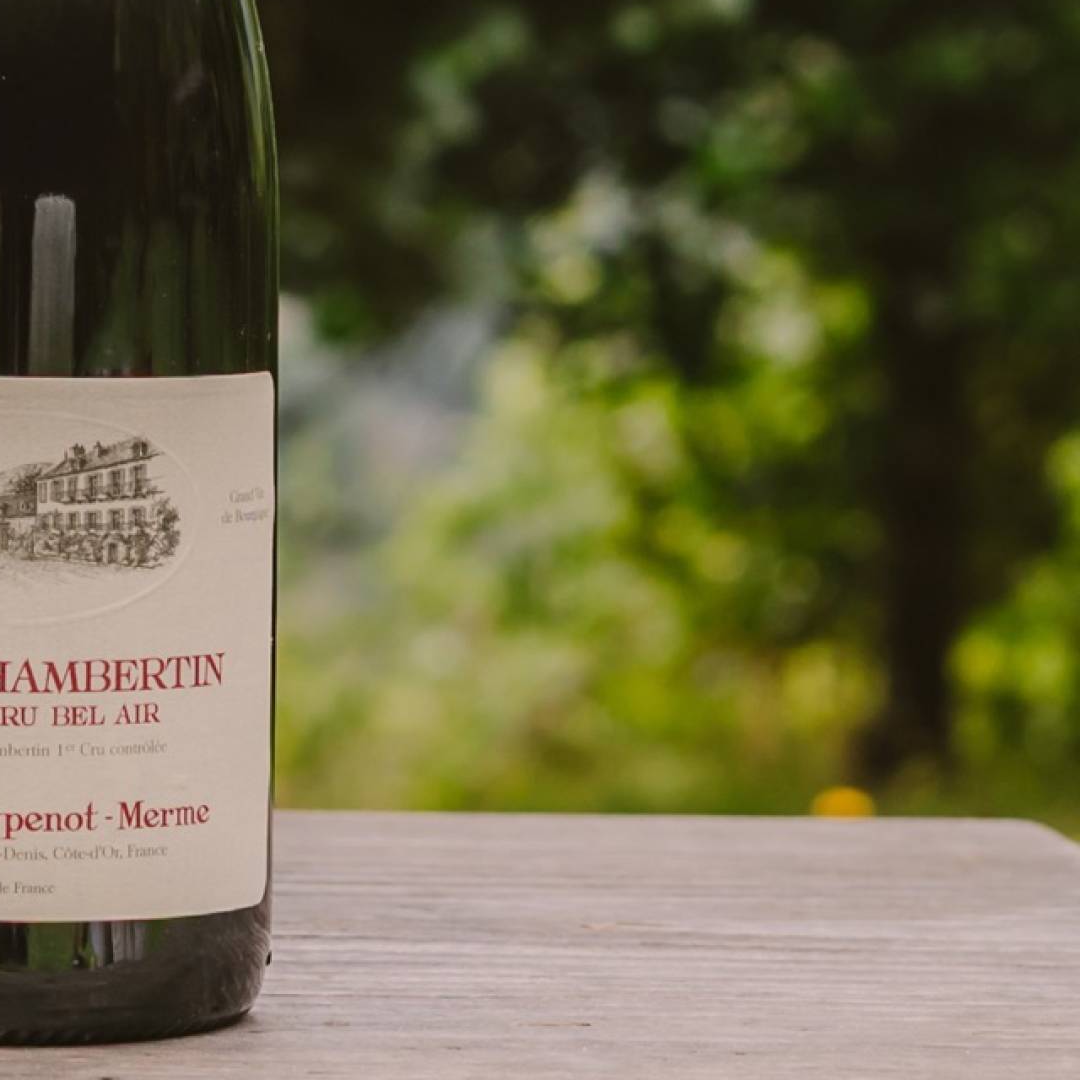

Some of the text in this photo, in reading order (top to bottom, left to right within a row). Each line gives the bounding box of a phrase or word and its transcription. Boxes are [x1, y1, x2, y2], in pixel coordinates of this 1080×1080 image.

[52, 706, 105, 726] BEL
[115, 703, 160, 724] AIR
[80, 743, 106, 757] Cru
[128, 843, 167, 857] France
[14, 881, 55, 894] France
